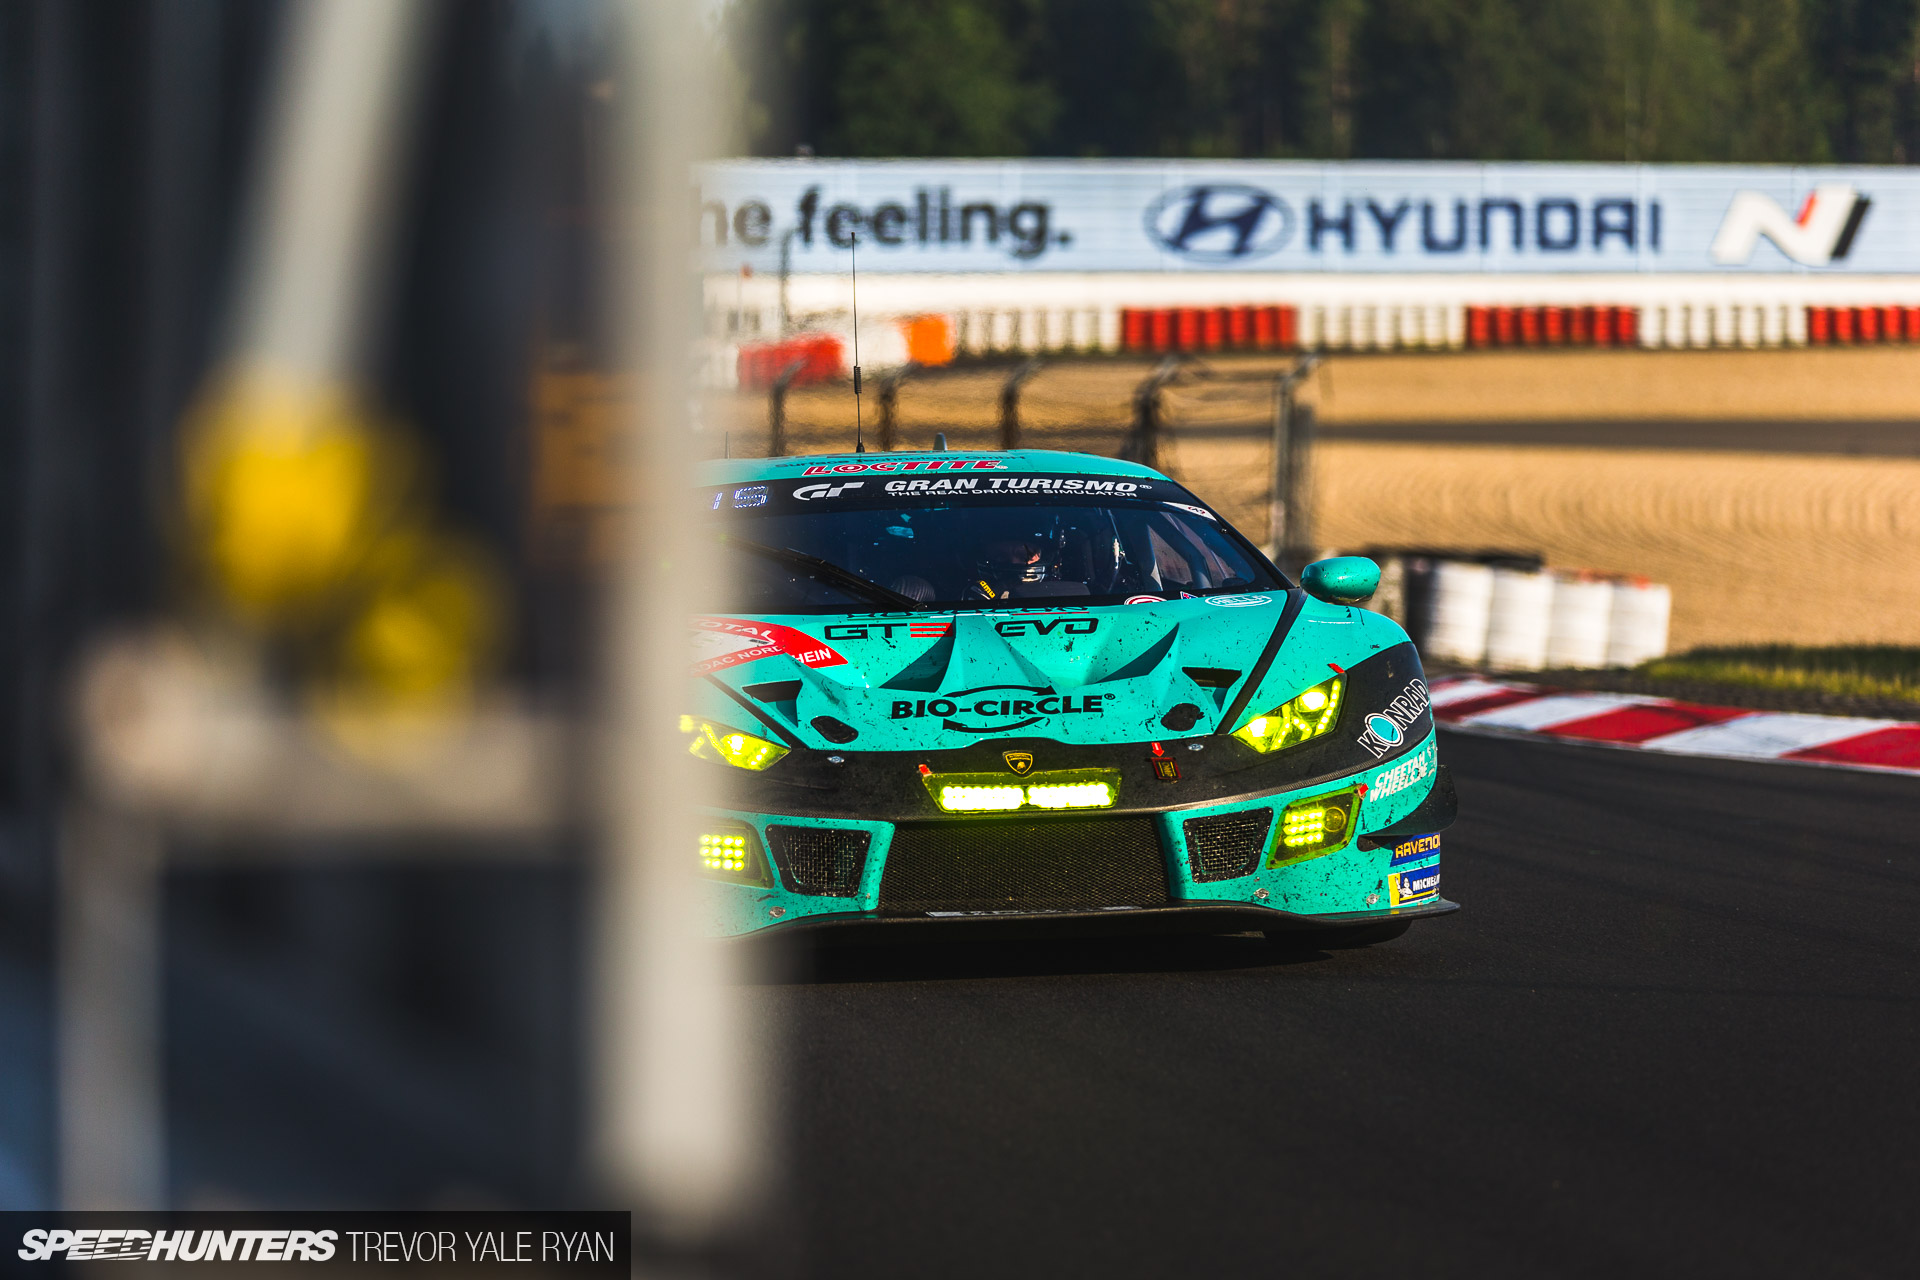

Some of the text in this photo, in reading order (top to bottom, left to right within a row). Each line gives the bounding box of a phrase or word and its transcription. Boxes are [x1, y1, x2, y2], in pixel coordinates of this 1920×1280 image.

[797, 185, 1073, 259] feeling.
[1308, 197, 1661, 254] HYUNDAI
[884, 478, 979, 492] GRAN
[1043, 489, 1138, 498] SIMULATOR
[994, 617, 1099, 638] EVO
[1356, 678, 1430, 759] KONRAD
[1374, 750, 1426, 788] CHEETAH
